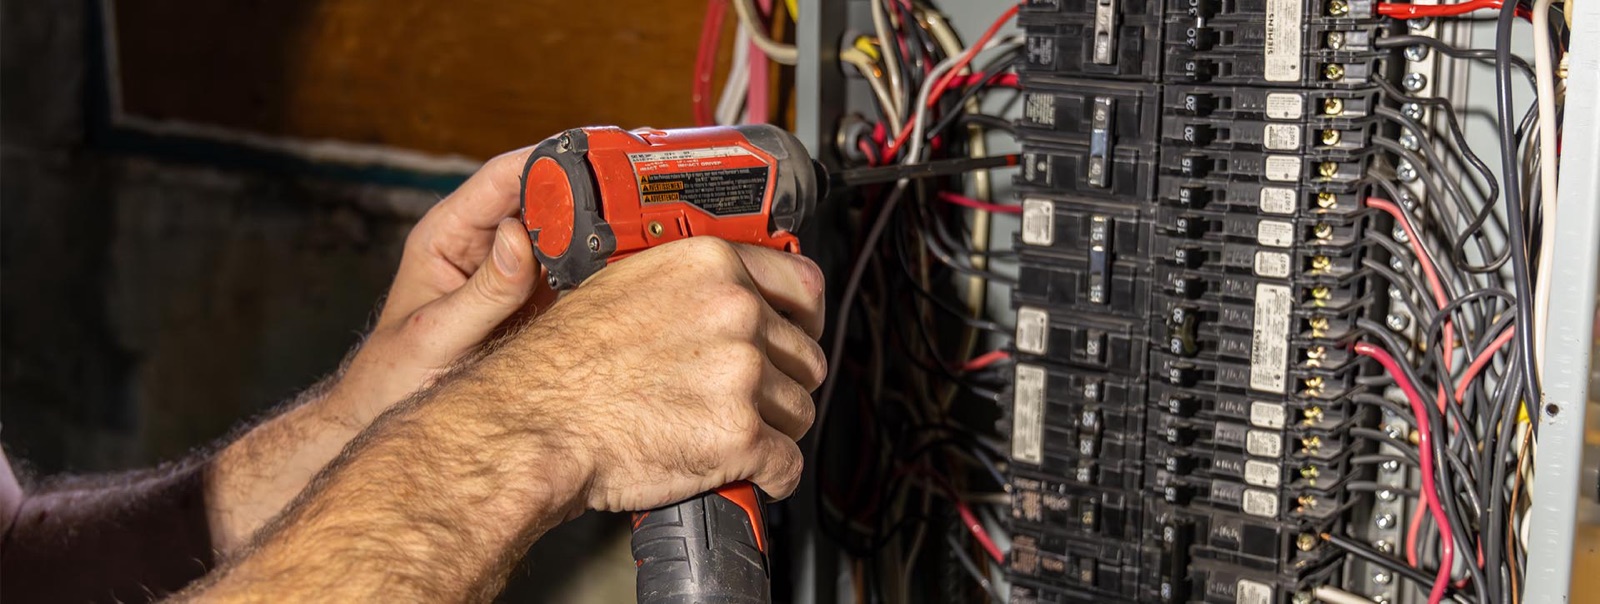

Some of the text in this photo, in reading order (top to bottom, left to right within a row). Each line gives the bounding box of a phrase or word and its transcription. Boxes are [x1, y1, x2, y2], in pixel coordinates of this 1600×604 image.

[1186, 28, 1196, 47] 30
[1266, 13, 1275, 55] SIEMENS
[1185, 62, 1196, 77] 15
[1186, 96, 1195, 111] 20
[1095, 109, 1105, 121] 40
[1184, 126, 1194, 142] 20
[1182, 158, 1191, 173] 15
[650, 193, 679, 202] ADVERTENCIA
[1180, 188, 1190, 204] 15
[1177, 218, 1186, 233] 15
[1092, 227, 1103, 240] 15
[1175, 249, 1185, 264] 15
[1175, 279, 1185, 294] 15
[1173, 308, 1184, 323] 30
[1086, 340, 1098, 355] 20
[1170, 338, 1181, 354] 30
[1252, 329, 1262, 365] SIEMENS
[1170, 368, 1180, 384] 15
[1169, 398, 1179, 414] 15
[1082, 411, 1095, 427] 25
[1166, 427, 1177, 443] 15
[1080, 440, 1093, 455] 25
[1166, 457, 1177, 472] 15
[1165, 486, 1176, 501] 15
